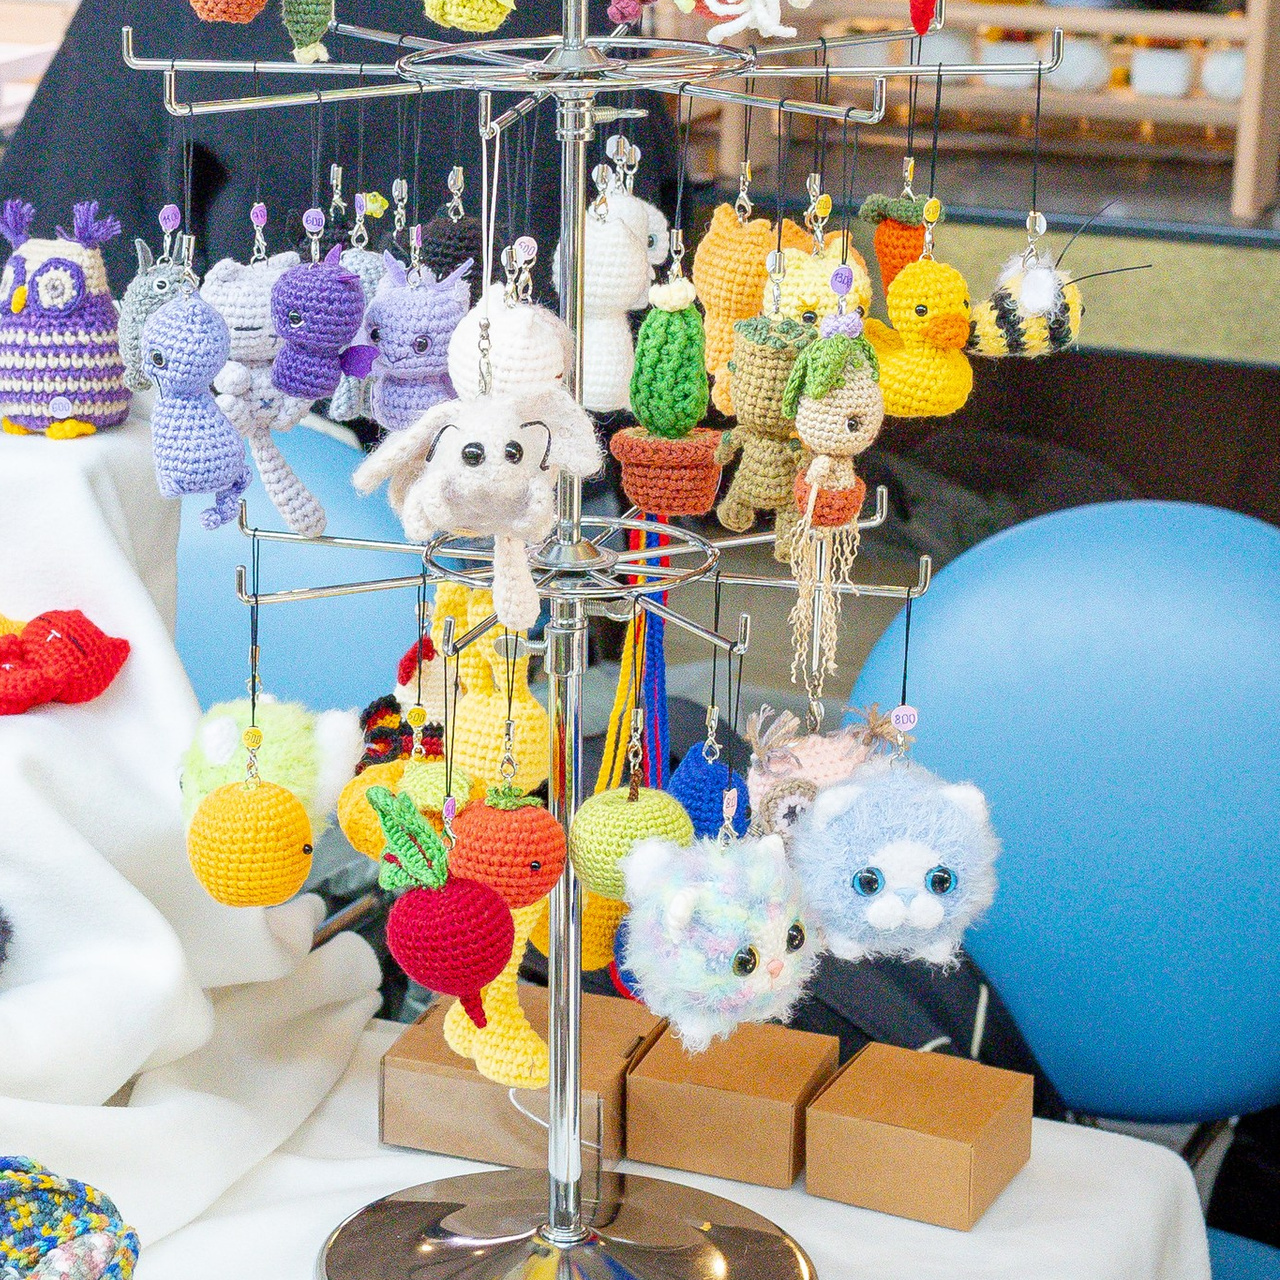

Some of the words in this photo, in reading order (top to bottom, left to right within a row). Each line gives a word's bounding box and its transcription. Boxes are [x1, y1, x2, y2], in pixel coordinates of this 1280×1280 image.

[305, 214, 324, 227] 600
[518, 241, 535, 256] 500
[51, 401, 70, 413] 600
[408, 711, 425, 723] 500
[894, 713, 916, 725] 800
[243, 731, 261, 744] 500
